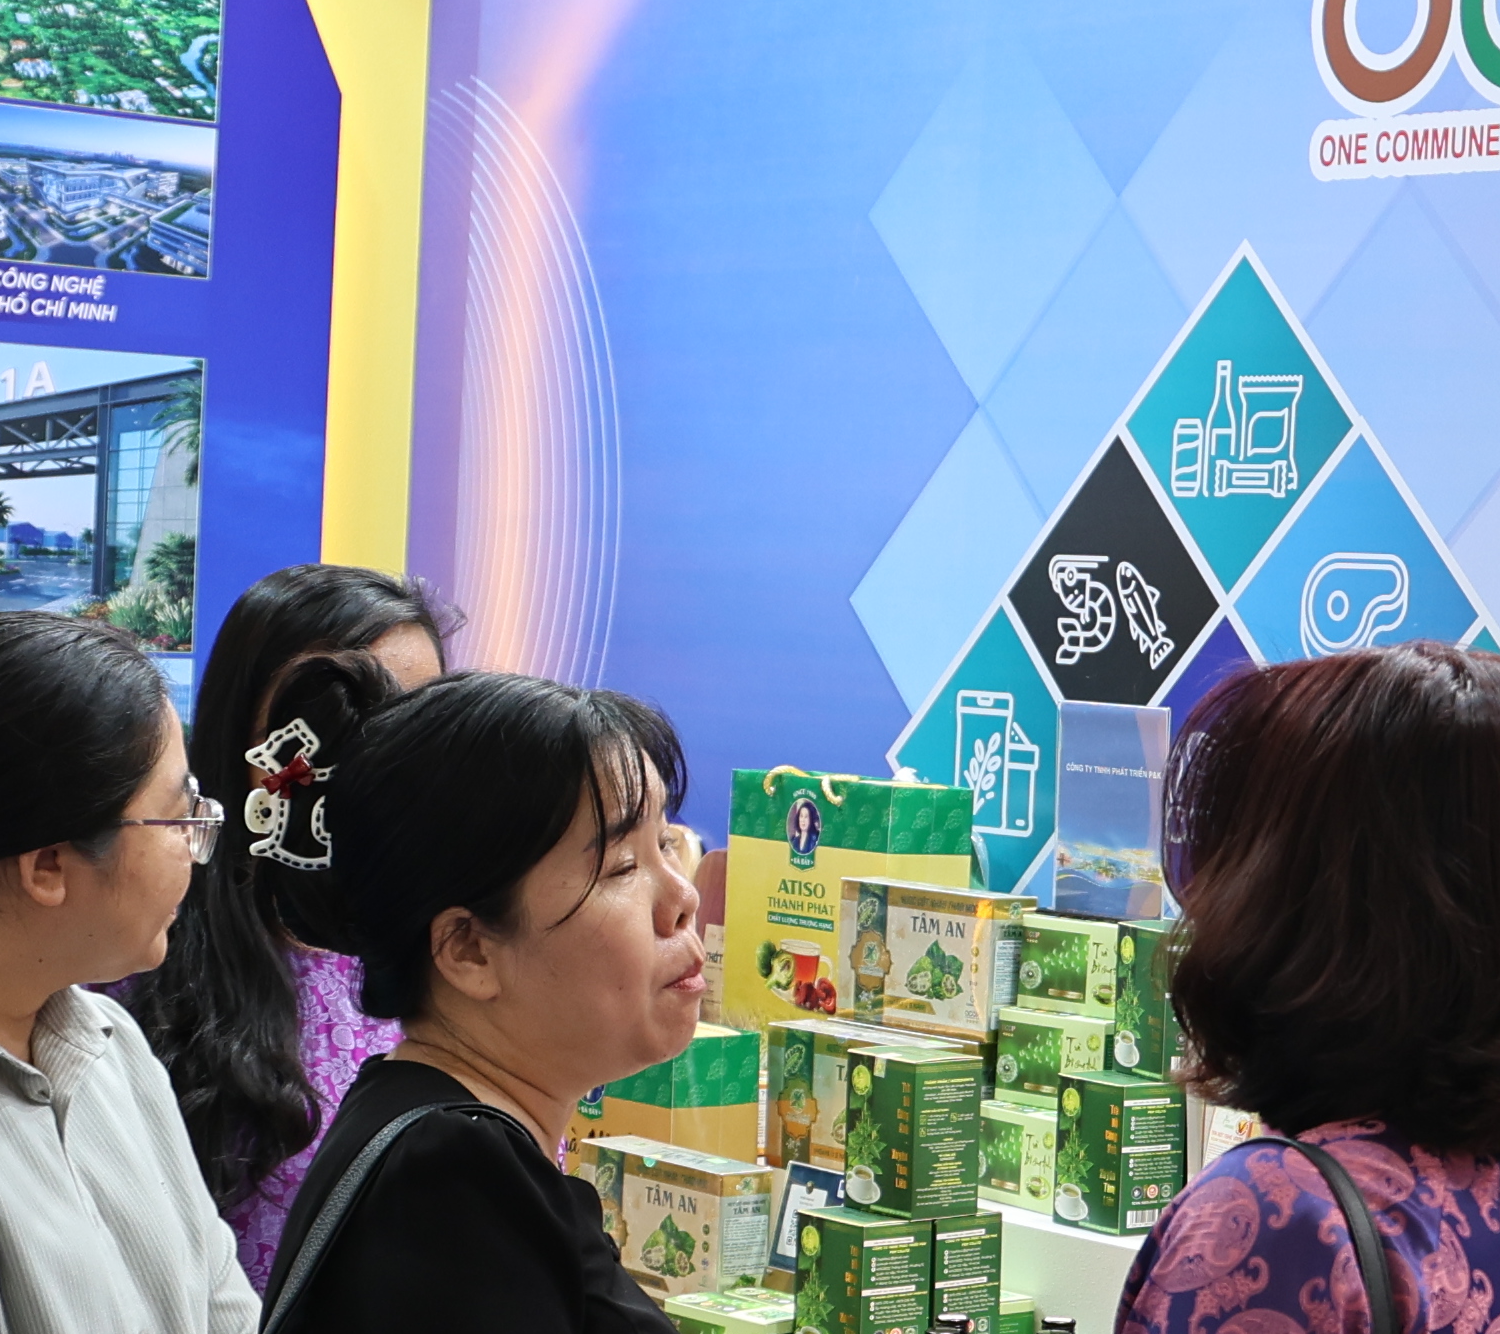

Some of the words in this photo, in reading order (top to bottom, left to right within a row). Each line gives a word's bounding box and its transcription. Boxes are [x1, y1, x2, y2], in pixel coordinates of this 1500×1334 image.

[1319, 133, 1369, 168] ONE
[1375, 124, 1500, 164] COMMUNE
[50, 274, 106, 300] NGHỆ
[31, 292, 65, 318] CHÍ
[67, 301, 117, 323] MINH
[0, 360, 56, 403] 1A
[777, 878, 826, 899] ATISO
[767, 896, 804, 913] THANH
[910, 913, 941, 935] TÂM
[944, 918, 966, 938] AN
